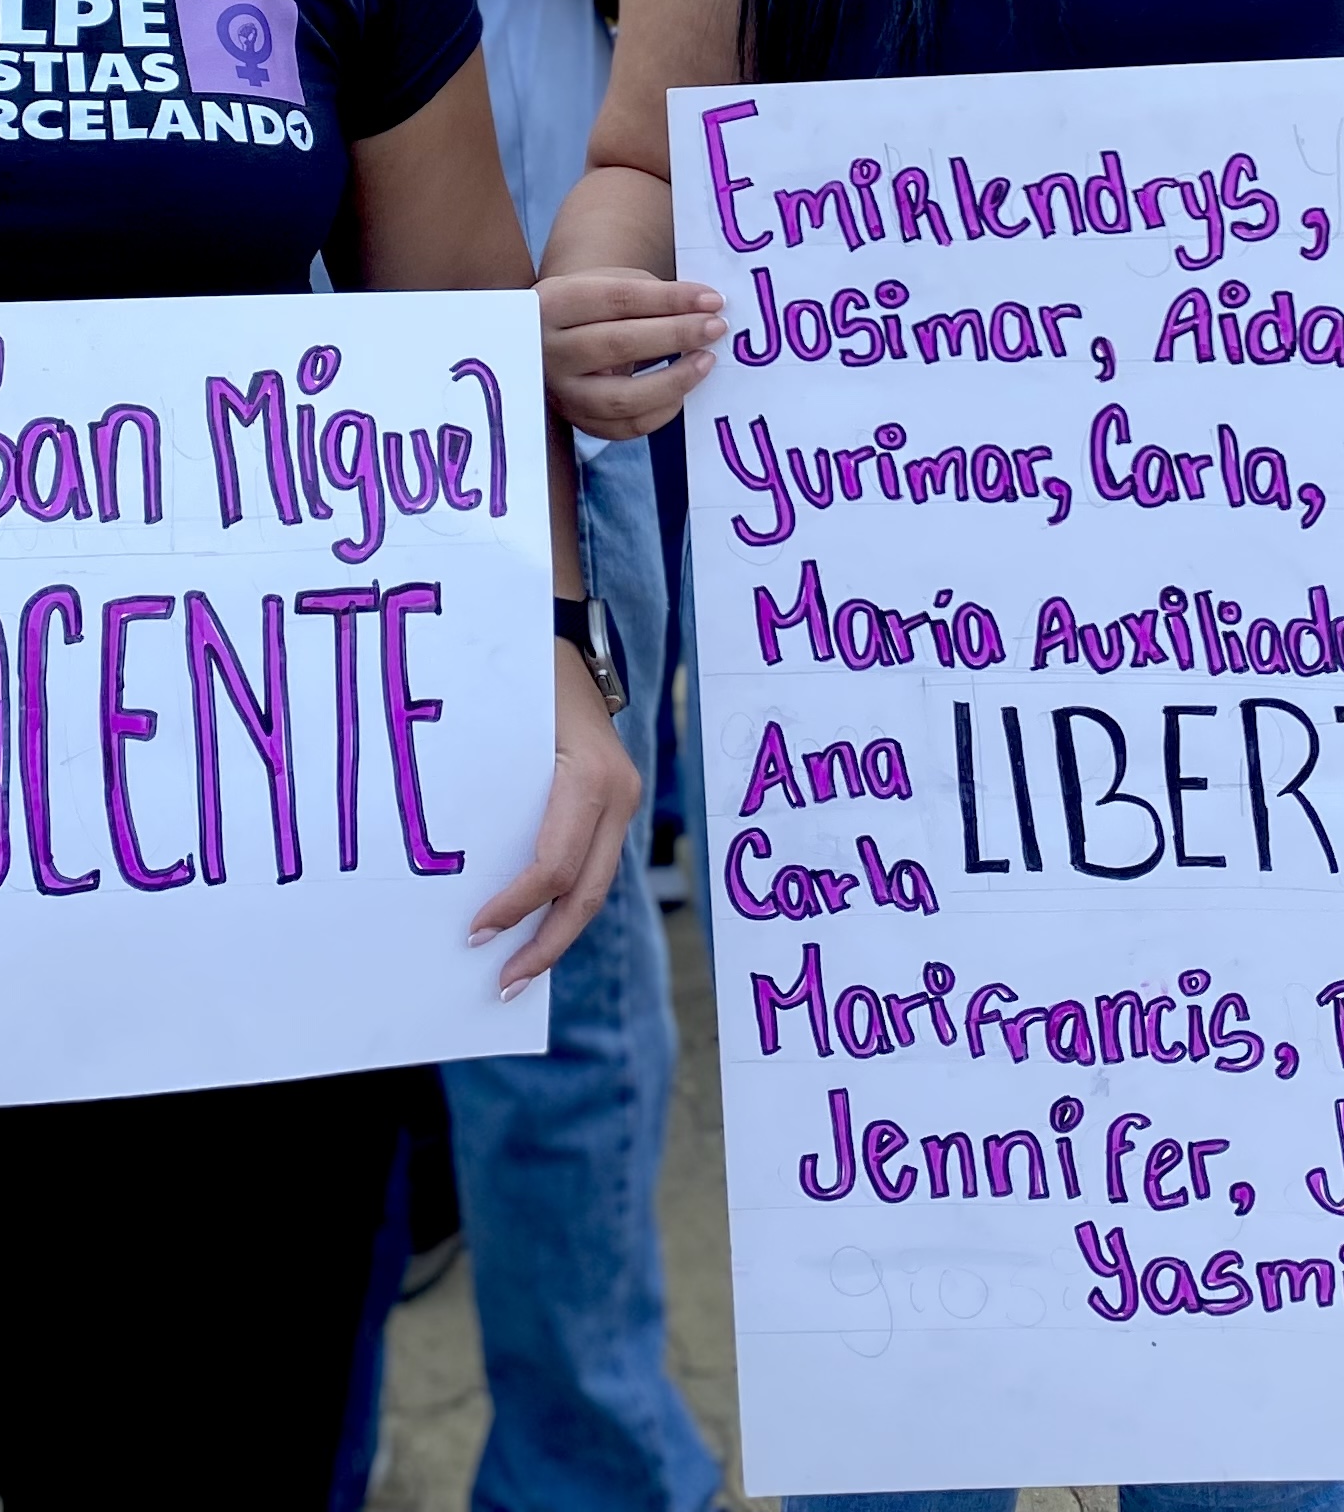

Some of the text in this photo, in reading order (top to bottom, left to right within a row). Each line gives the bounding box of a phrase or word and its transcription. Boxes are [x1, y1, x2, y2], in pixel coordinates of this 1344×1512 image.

[733, 267, 1116, 382] Josimar,
[206, 345, 507, 565] Miguel
[714, 415, 1072, 547] Yurimar,
[1090, 402, 1326, 529] Carla,
[753, 559, 1006, 672] María
[739, 721, 913, 817] Ana
[724, 827, 940, 922] Carla
[750, 943, 1299, 1080] Marifrancis,
[799, 1087, 1256, 1217] Jennifer,
